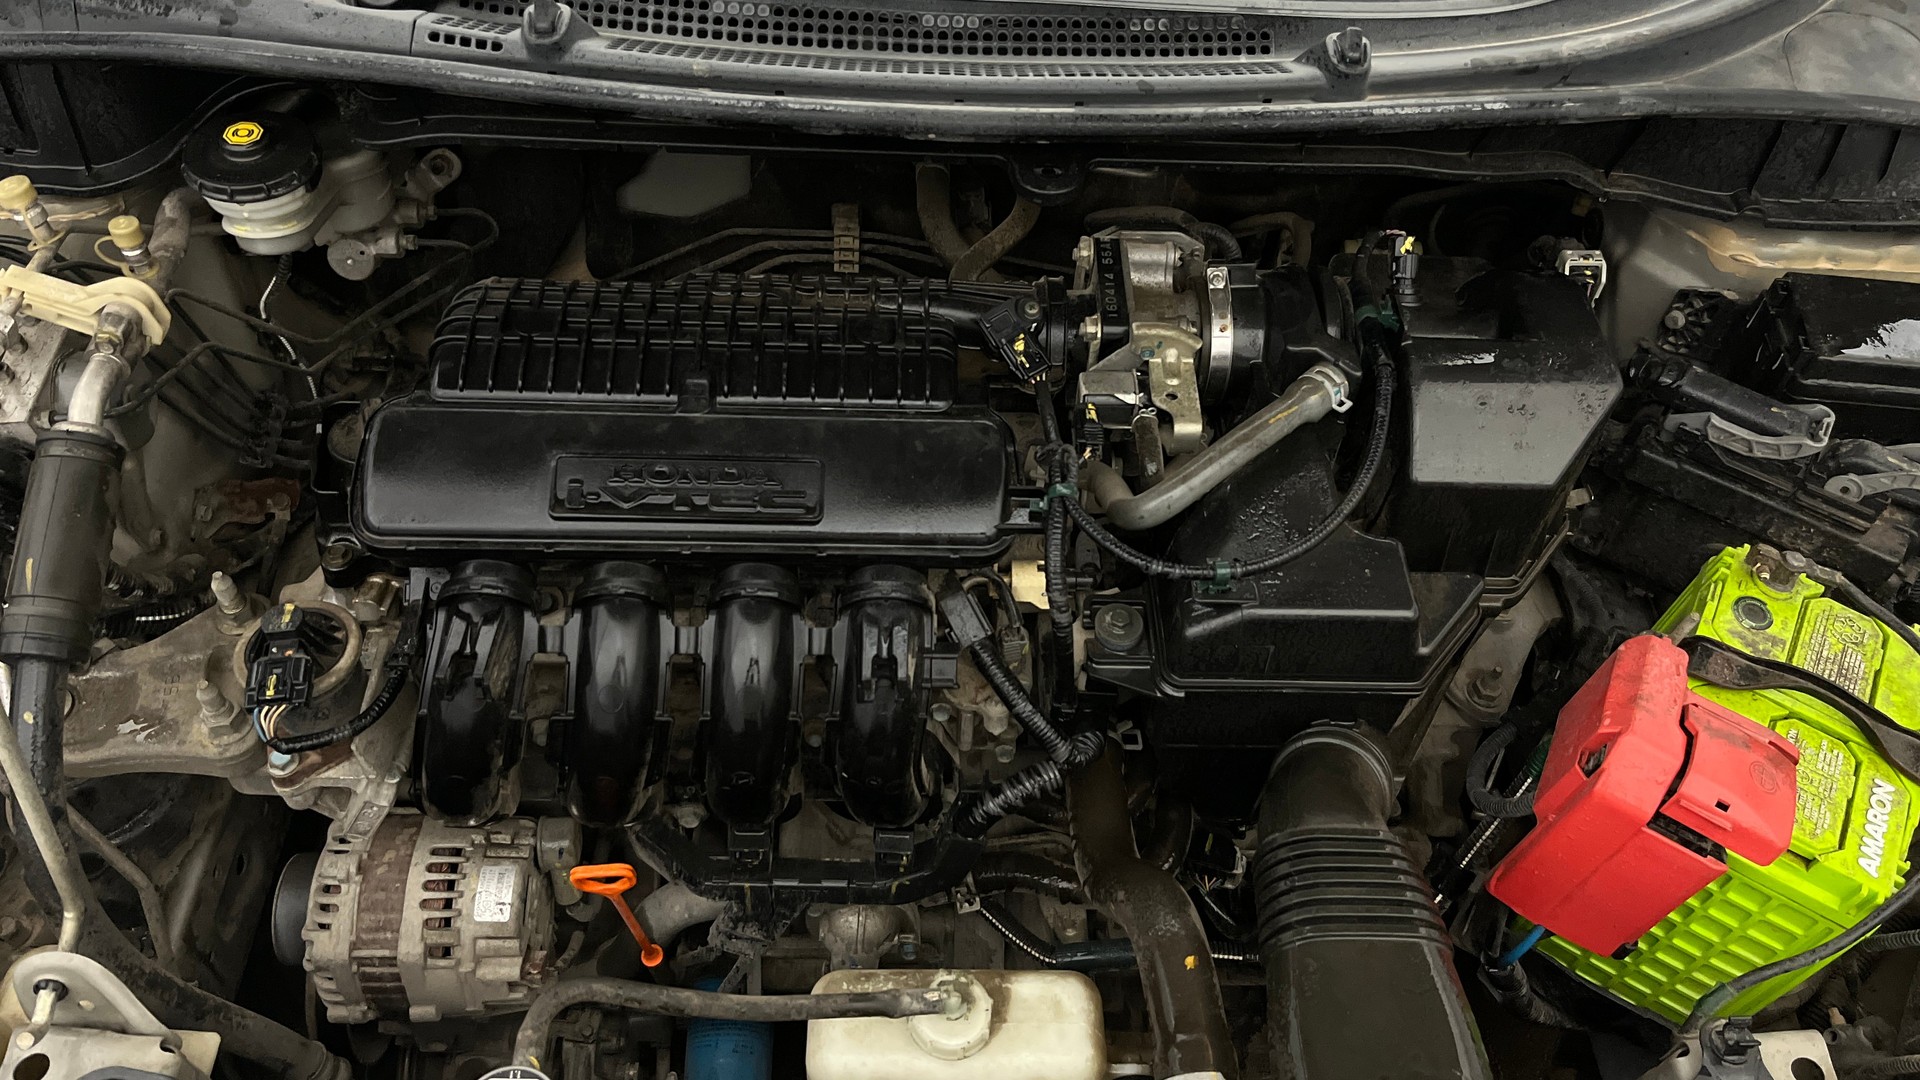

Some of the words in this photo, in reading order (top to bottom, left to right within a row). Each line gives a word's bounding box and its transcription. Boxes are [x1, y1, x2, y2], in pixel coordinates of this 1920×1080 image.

[1104, 273, 1118, 317] 160414
[606, 463, 783, 488] HONDA
[1857, 778, 1897, 880] AMARON
